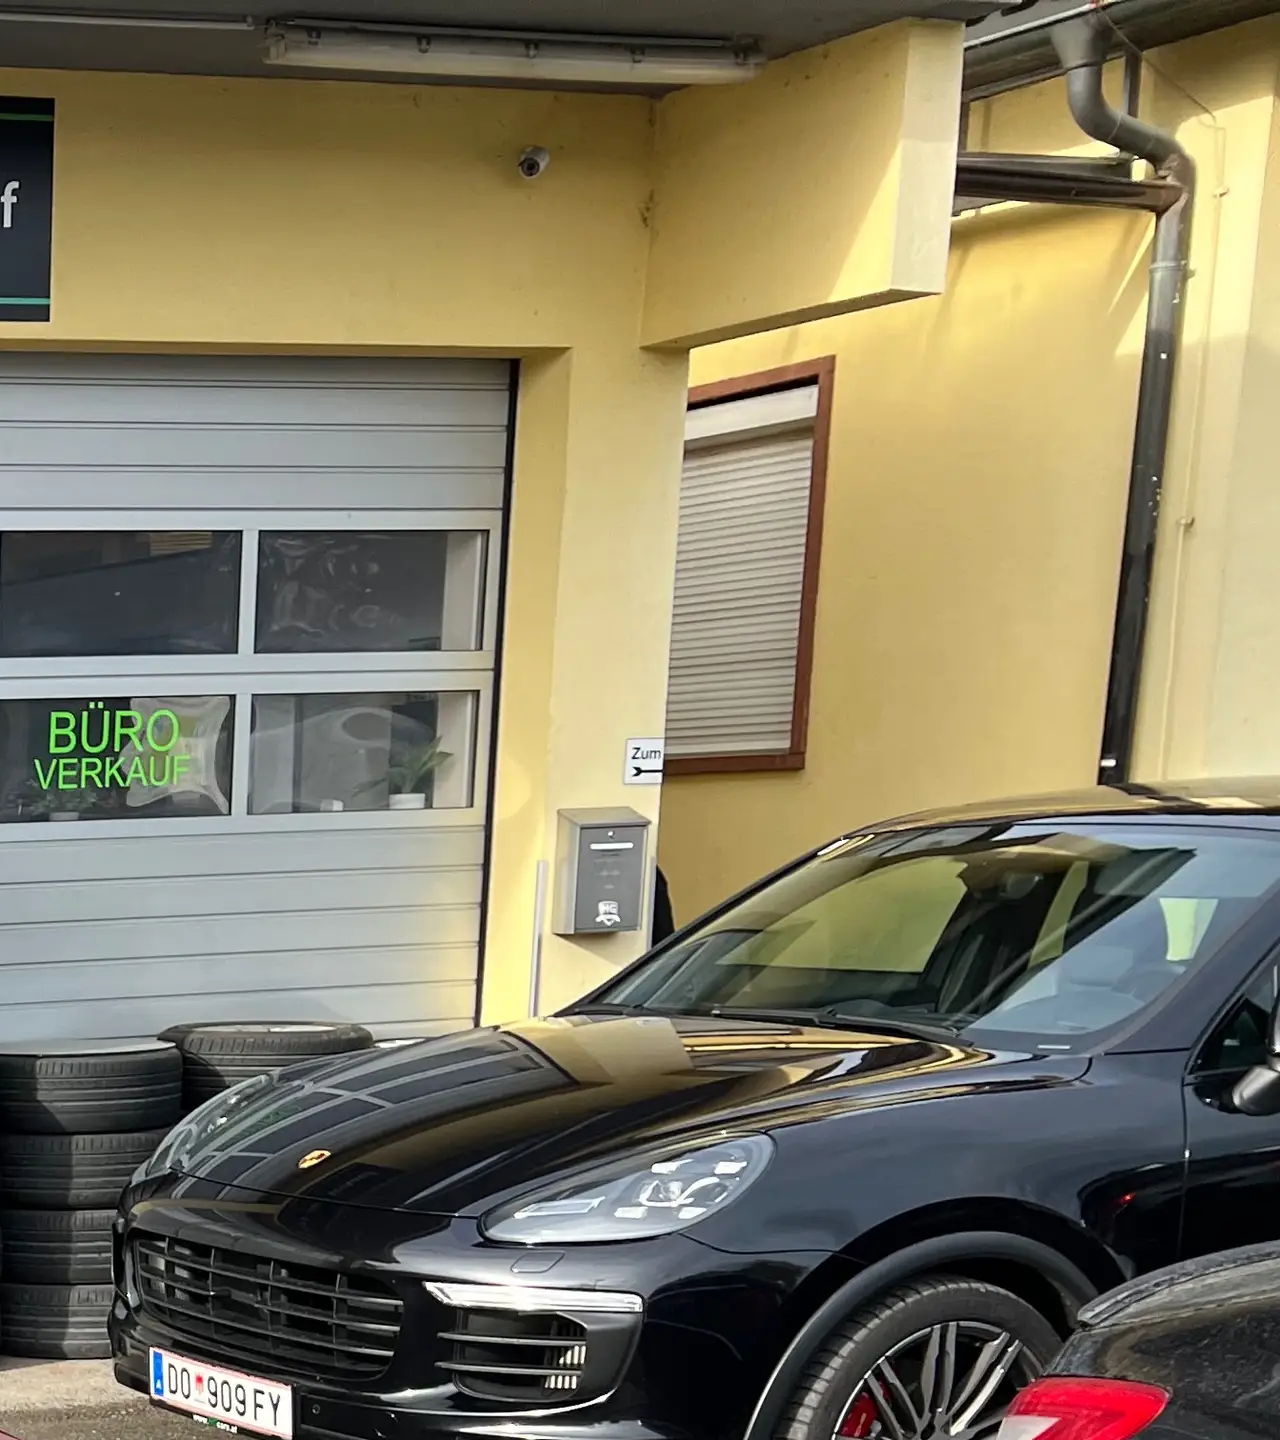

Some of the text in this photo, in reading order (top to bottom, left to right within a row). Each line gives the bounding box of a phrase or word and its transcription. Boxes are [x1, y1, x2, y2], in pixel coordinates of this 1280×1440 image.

[48, 701, 180, 754] BÜRO
[631, 747, 662, 760] Zum
[33, 755, 191, 790] VERKAUF
[167, 1363, 191, 1400] DO
